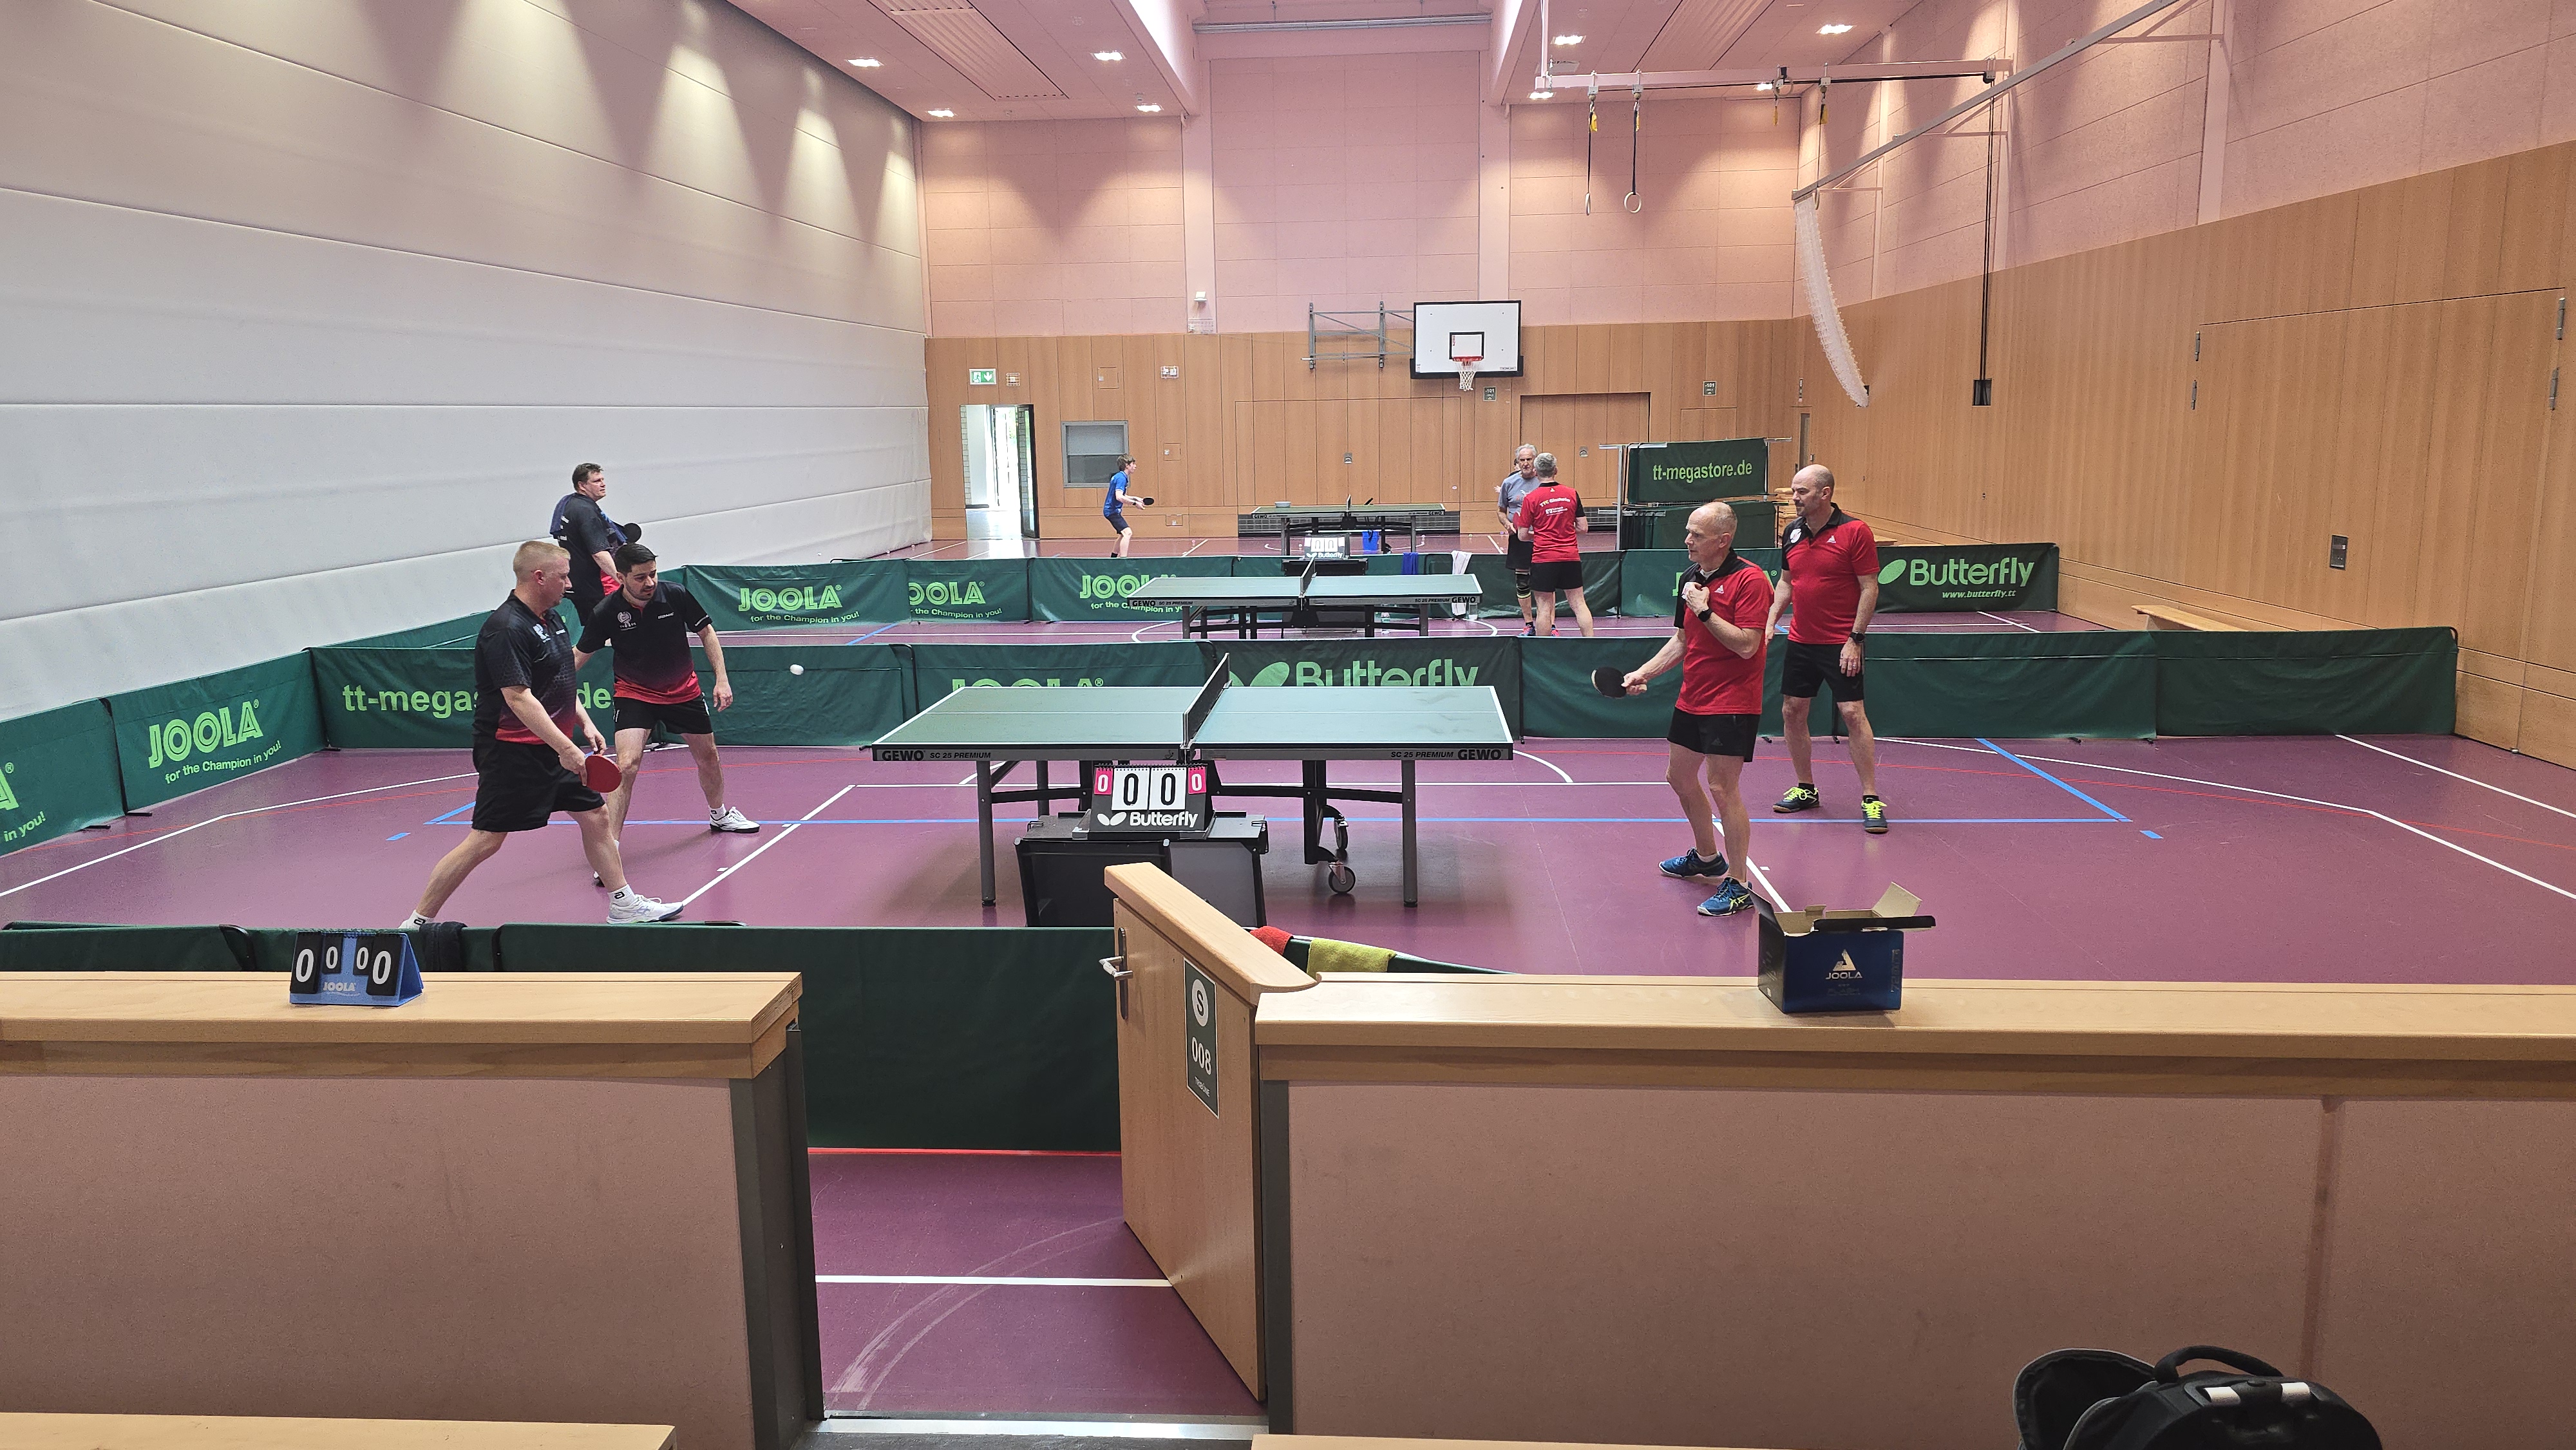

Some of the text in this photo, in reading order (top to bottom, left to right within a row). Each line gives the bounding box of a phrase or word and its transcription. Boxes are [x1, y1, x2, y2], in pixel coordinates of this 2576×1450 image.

[1653, 460, 1752, 484] tt-megastore.de
[1909, 557, 2034, 587] Butterfly
[1942, 589, 2017, 599] www.butterfly.tt
[784, 614, 829, 624] Champion
[841, 611, 860, 623] you!
[931, 608, 974, 619] Champion
[985, 607, 1003, 618] you!
[1296, 659, 1479, 686] Butterfly
[165, 740, 282, 784] for the Champion in you!
[882, 749, 924, 761] GEWO
[1457, 749, 1502, 760] GEWO
[1097, 773, 1202, 806] 0 0 0 0
[4, 811, 46, 842] in you!
[1130, 811, 1198, 828] Butterfly
[296, 946, 392, 984] 0 0 0 0
[1825, 971, 1863, 980] JOOLA
[1197, 990, 1204, 1017] S
[1191, 1037, 1211, 1075] 008
